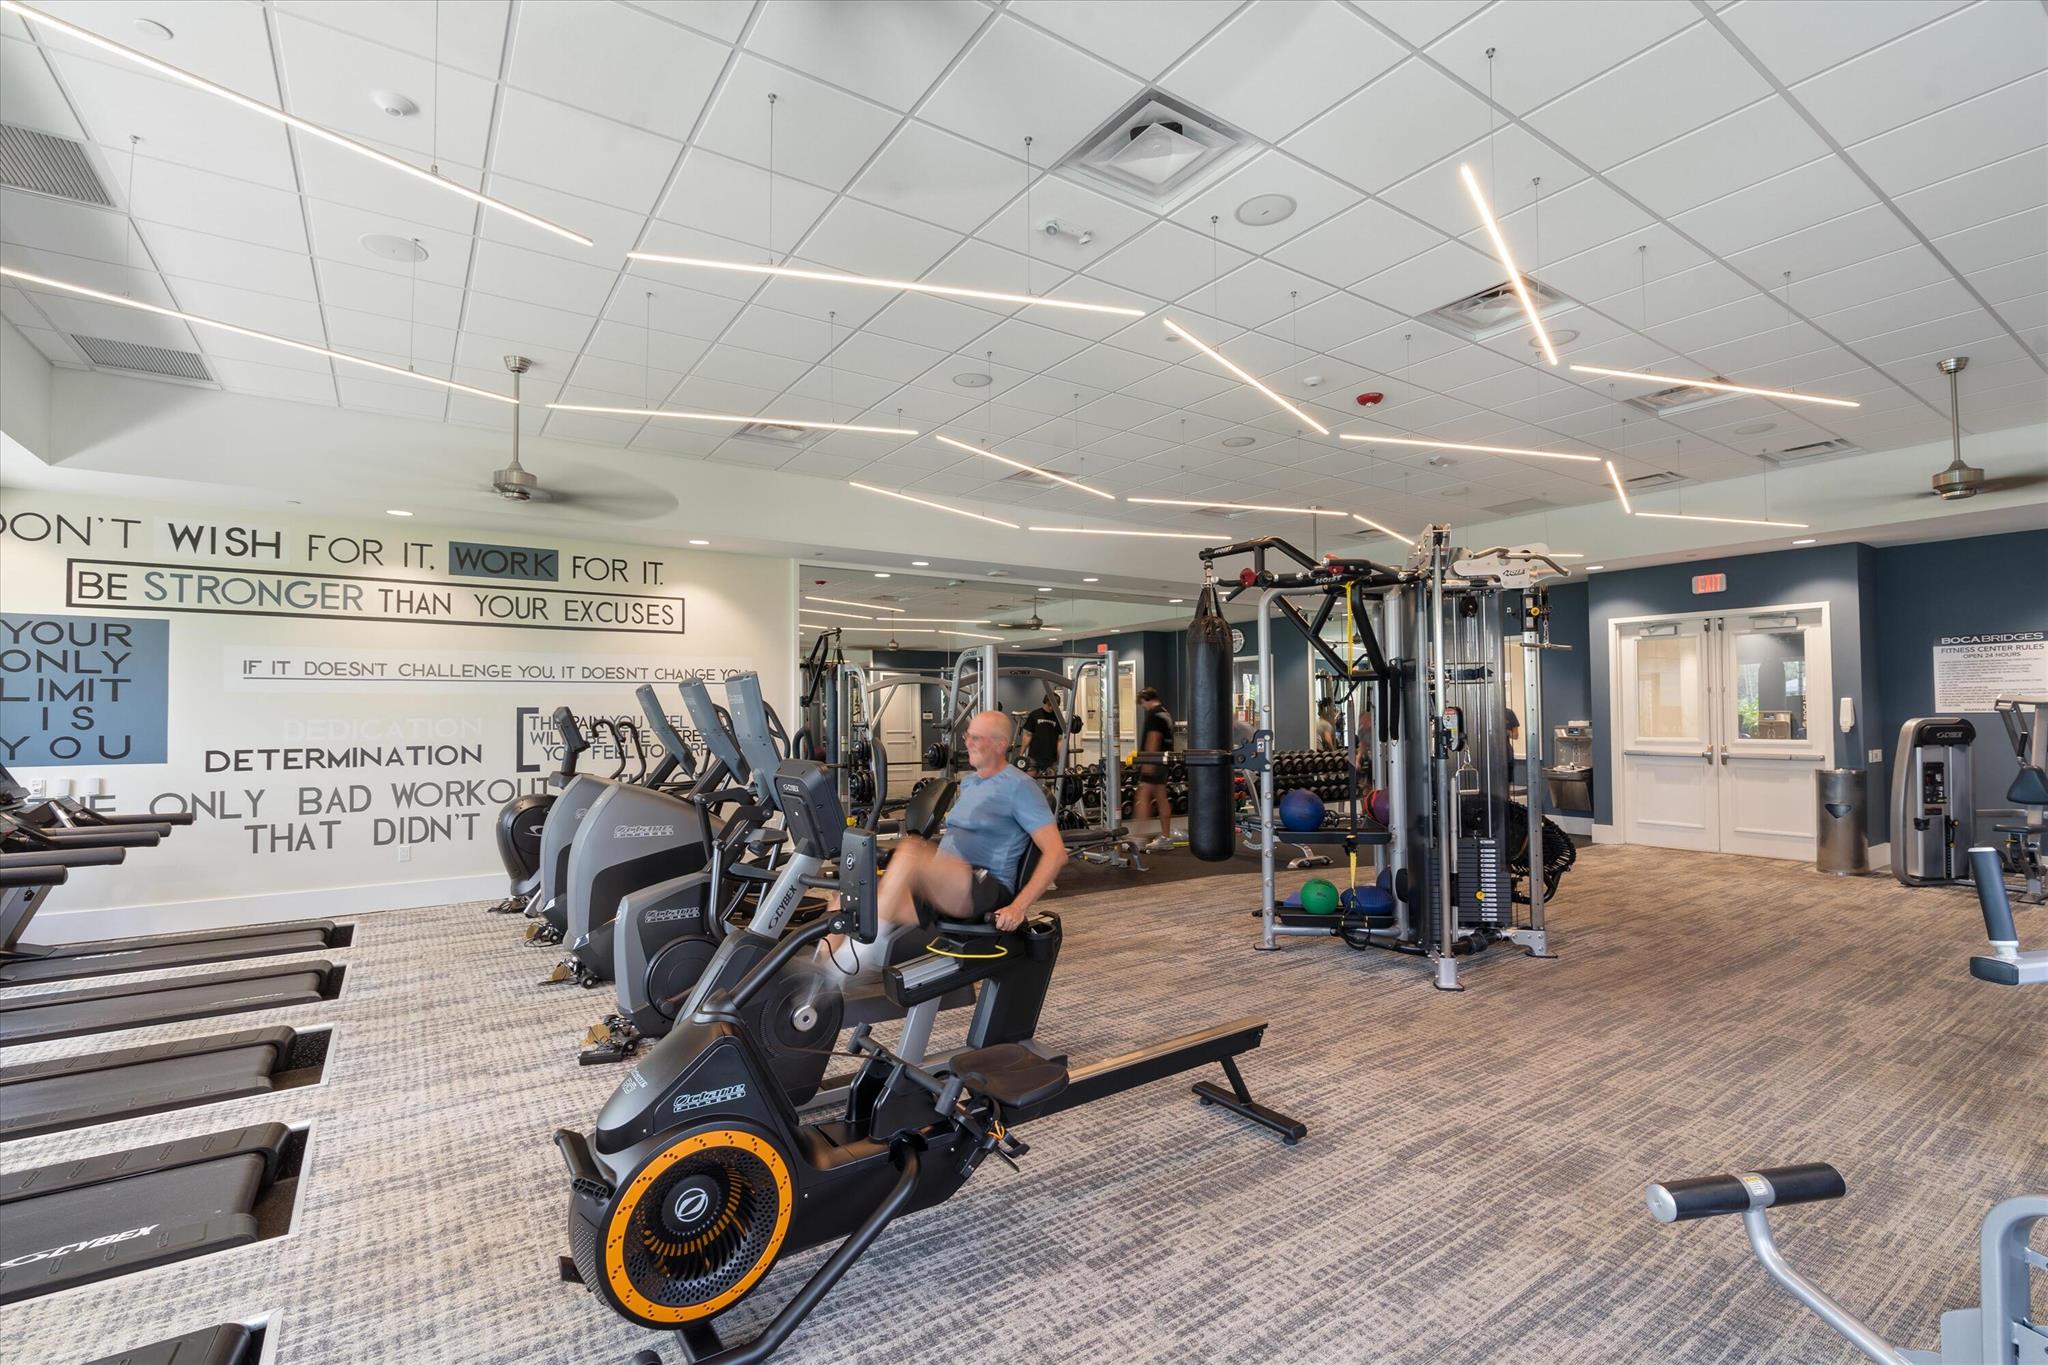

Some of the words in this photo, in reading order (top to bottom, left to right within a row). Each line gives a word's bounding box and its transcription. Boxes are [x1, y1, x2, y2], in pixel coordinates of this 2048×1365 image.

[0, 512, 142, 549] ON'T
[168, 522, 282, 559] WISH
[308, 534, 384, 566] FOR
[454, 546, 555, 577] WORK
[572, 555, 629, 583] FOR
[1697, 575, 1721, 592] EXIT
[77, 570, 128, 600] BE
[144, 571, 363, 611] STRONGER
[378, 588, 451, 615] THAN
[474, 593, 550, 620] YOUR
[564, 600, 675, 626] EXCUSES
[0, 620, 133, 648] YOUR
[1941, 646, 1975, 654] FITNESS
[1977, 644, 2013, 653] CENTER
[2015, 643, 2045, 651] RULES
[0, 649, 131, 674] ONLY
[243, 660, 262, 675] IF
[272, 660, 291, 675] IT
[304, 661, 388, 677] DOESN'T
[398, 663, 512, 678] CHALLENGE
[561, 666, 575, 679] IT
[582, 666, 649, 680] DOESN'T
[654, 668, 716, 681] CHANGE
[0, 678, 131, 702] LIMIT
[42, 706, 95, 731] IS
[283, 717, 483, 741] DEDICATION
[0, 735, 131, 760] YOU
[530, 731, 563, 746] WIL
[205, 744, 482, 773] DETERMINATION
[150, 788, 266, 820] ONLY
[299, 785, 372, 816] BAD
[391, 777, 550, 808] WORKOUT
[244, 820, 341, 854] THAT
[373, 813, 480, 846] DIDN'T
[775, 884, 797, 917] CYBEX
[47, 1223, 161, 1259] CYBEX
